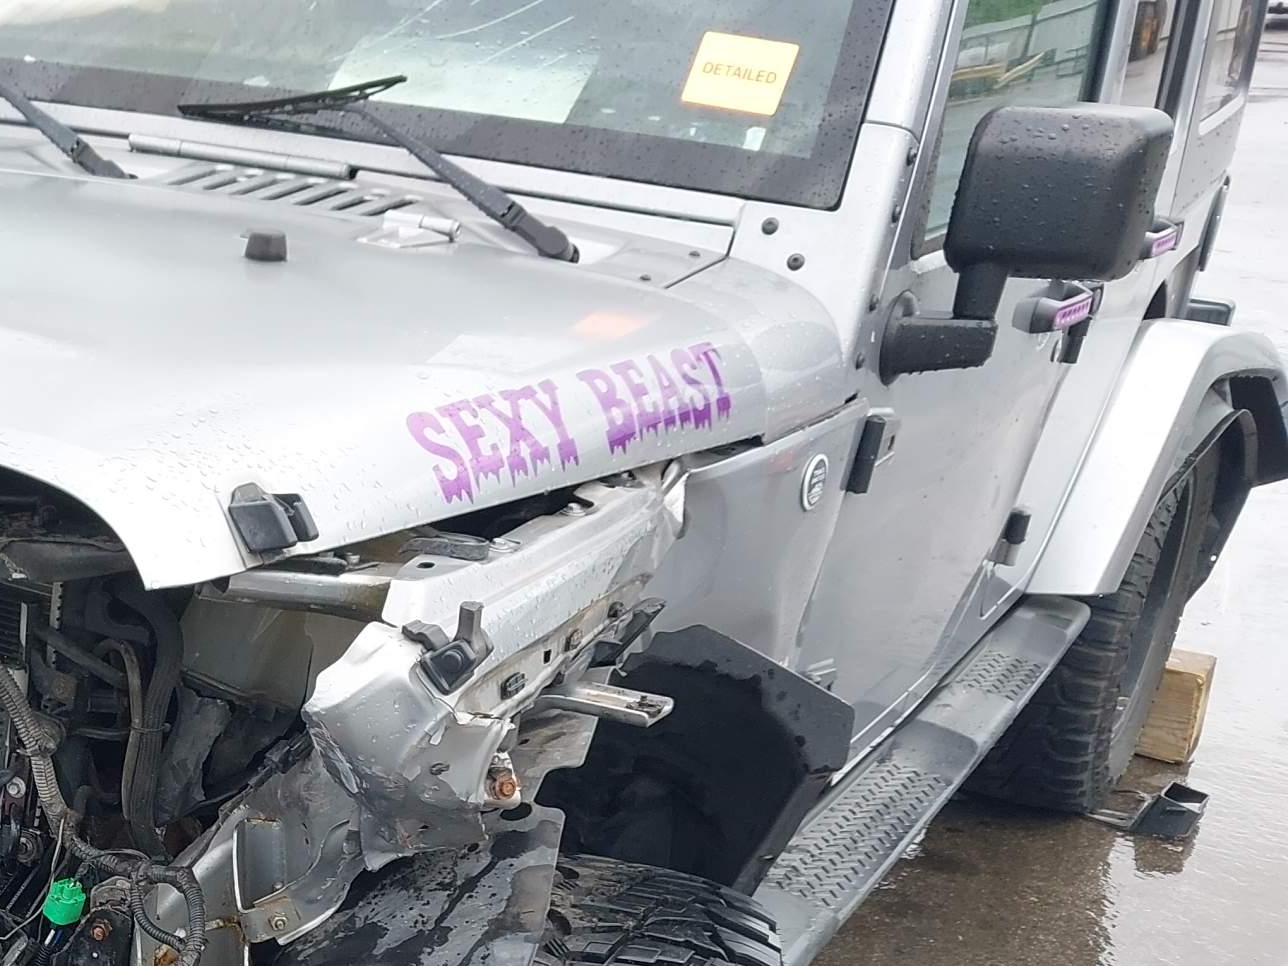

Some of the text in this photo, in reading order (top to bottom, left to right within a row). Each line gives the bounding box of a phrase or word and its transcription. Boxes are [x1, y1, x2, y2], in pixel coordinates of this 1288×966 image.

[702, 61, 777, 84] DETAILED
[406, 341, 731, 504] SEXY BEAST
